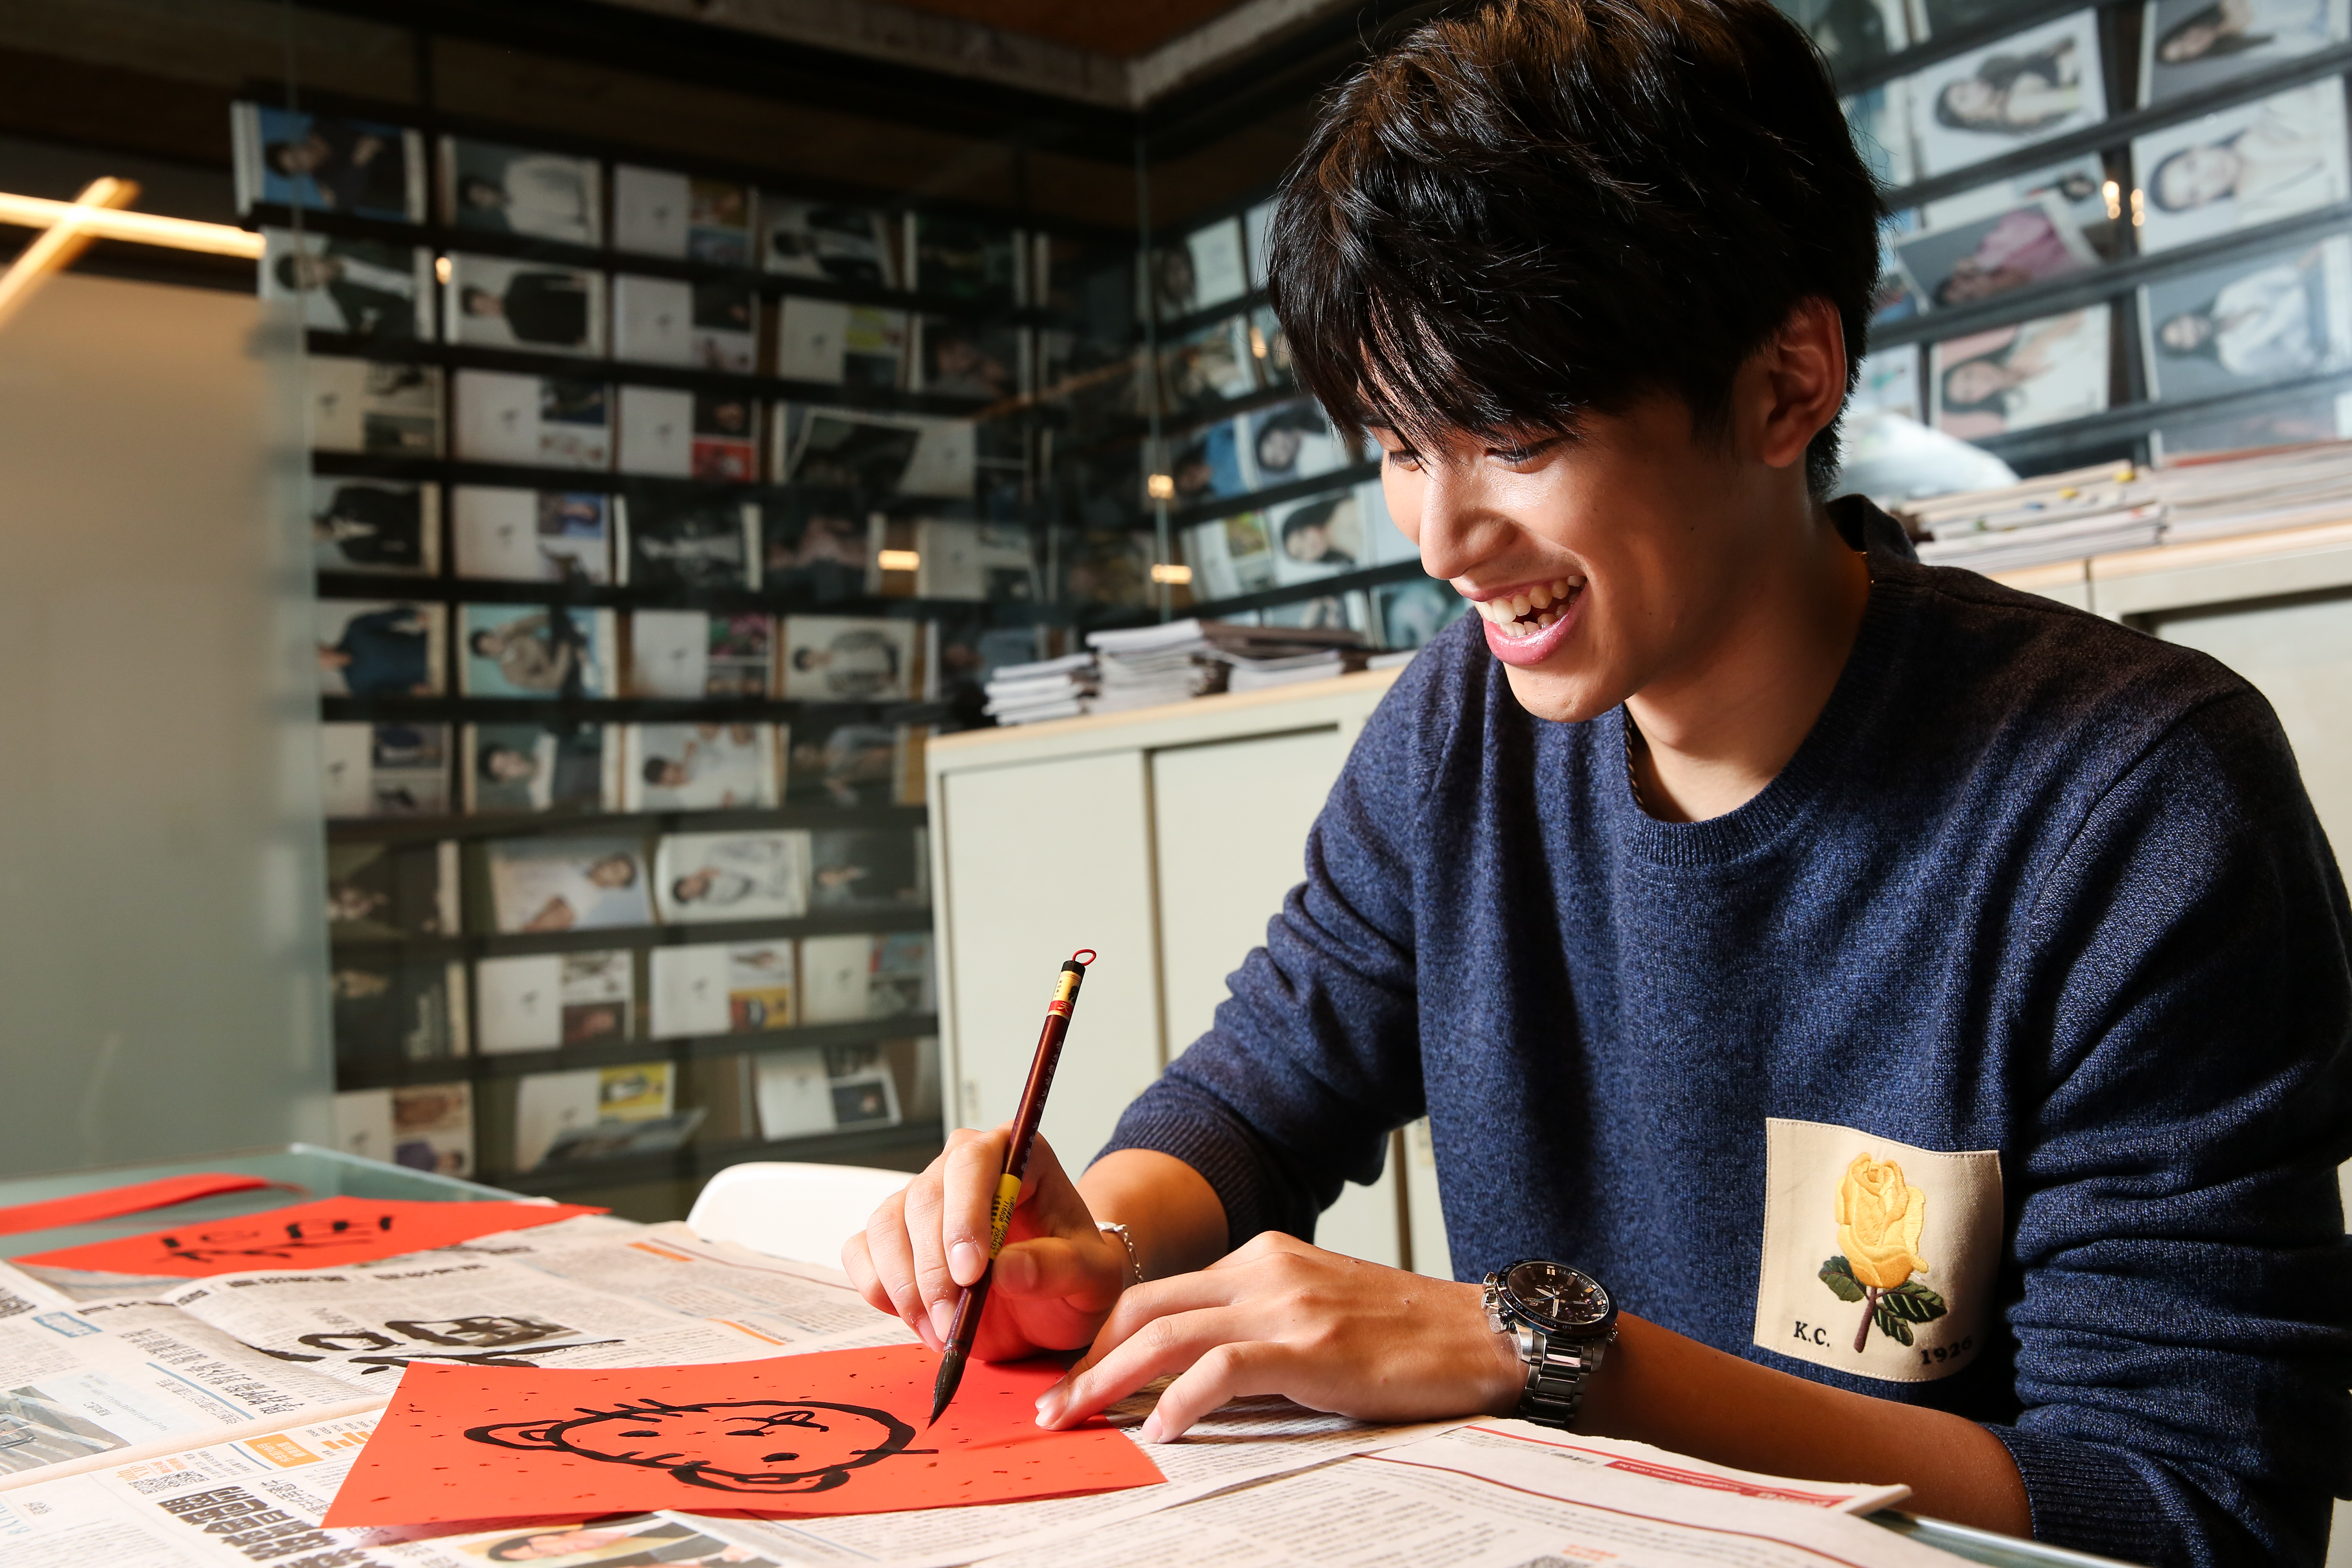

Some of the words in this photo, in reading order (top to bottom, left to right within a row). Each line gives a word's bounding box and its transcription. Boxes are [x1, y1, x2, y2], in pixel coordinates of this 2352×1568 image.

[998, 1199, 1011, 1223] 716608
[989, 1226, 1002, 1251] 200433
[1504, 1291, 1512, 1300] 300
[1513, 1301, 1523, 1310] 400
[1524, 1310, 1557, 1327] TACHYMETER
[1794, 1321, 1830, 1348] K.C.
[1921, 1336, 1973, 1365] 1926
